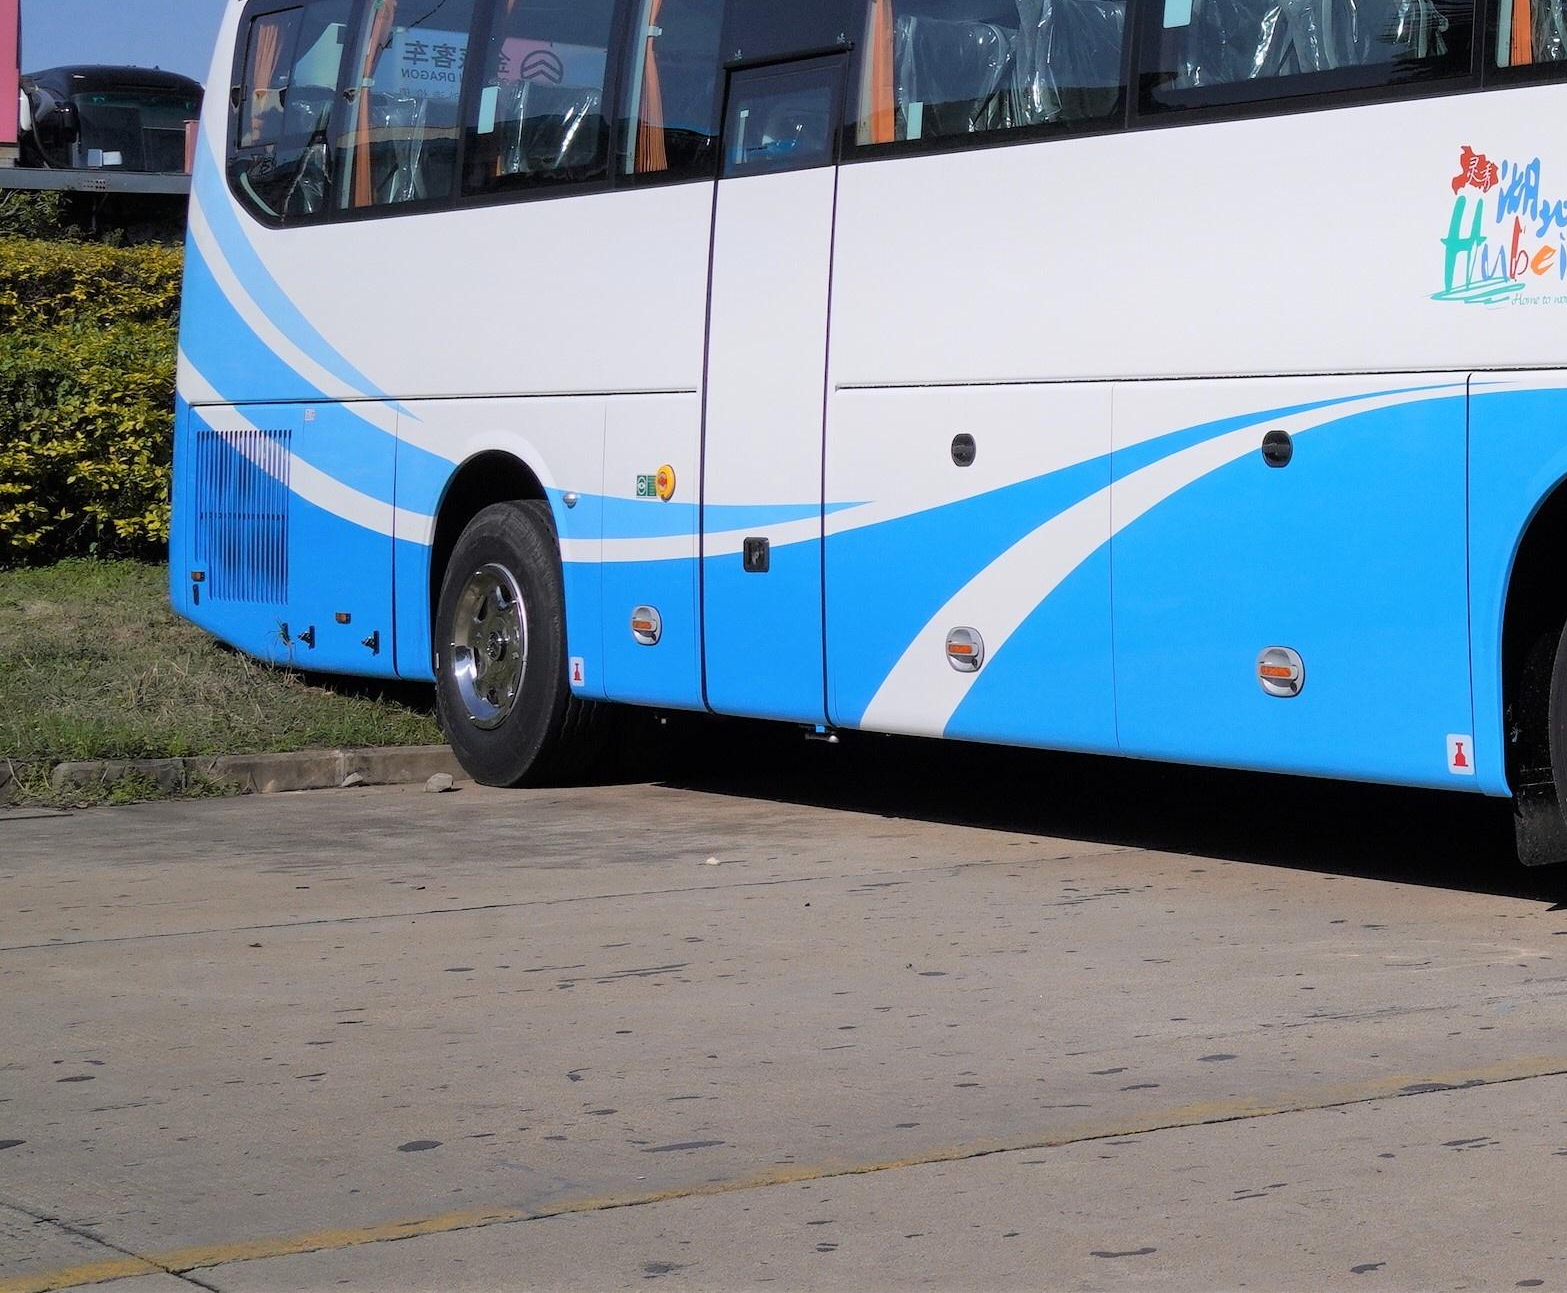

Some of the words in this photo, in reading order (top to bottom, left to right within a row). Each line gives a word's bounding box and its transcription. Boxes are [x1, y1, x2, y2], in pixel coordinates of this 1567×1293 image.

[1440, 194, 1567, 293] Hubei
[1511, 292, 1541, 306] Home
[1542, 294, 1551, 305] to
